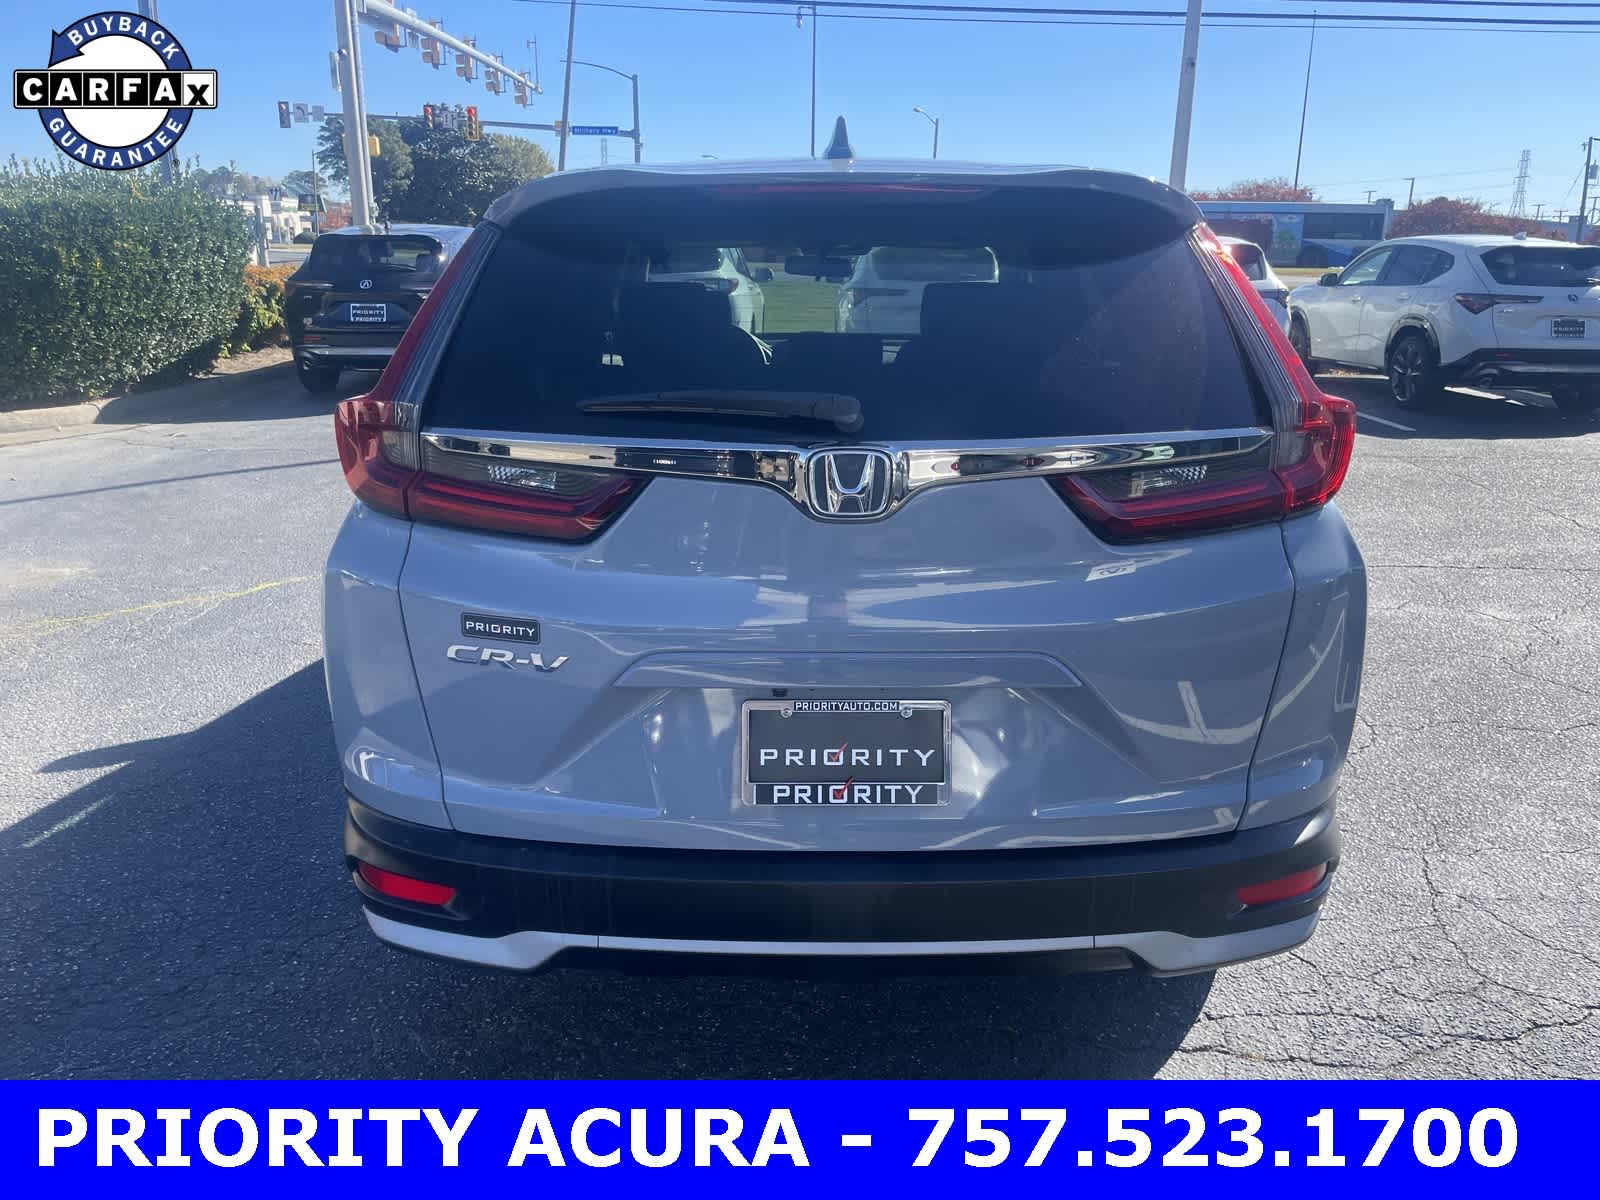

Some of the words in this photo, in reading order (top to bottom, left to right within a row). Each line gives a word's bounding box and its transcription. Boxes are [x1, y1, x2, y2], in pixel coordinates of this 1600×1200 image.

[465, 621, 535, 637] PRIORITY
[446, 645, 570, 672] CR-V
[795, 701, 898, 712] PRIORITYAUTO.COM
[759, 748, 935, 767] PRIORITY
[773, 784, 924, 805] PRIORITY
